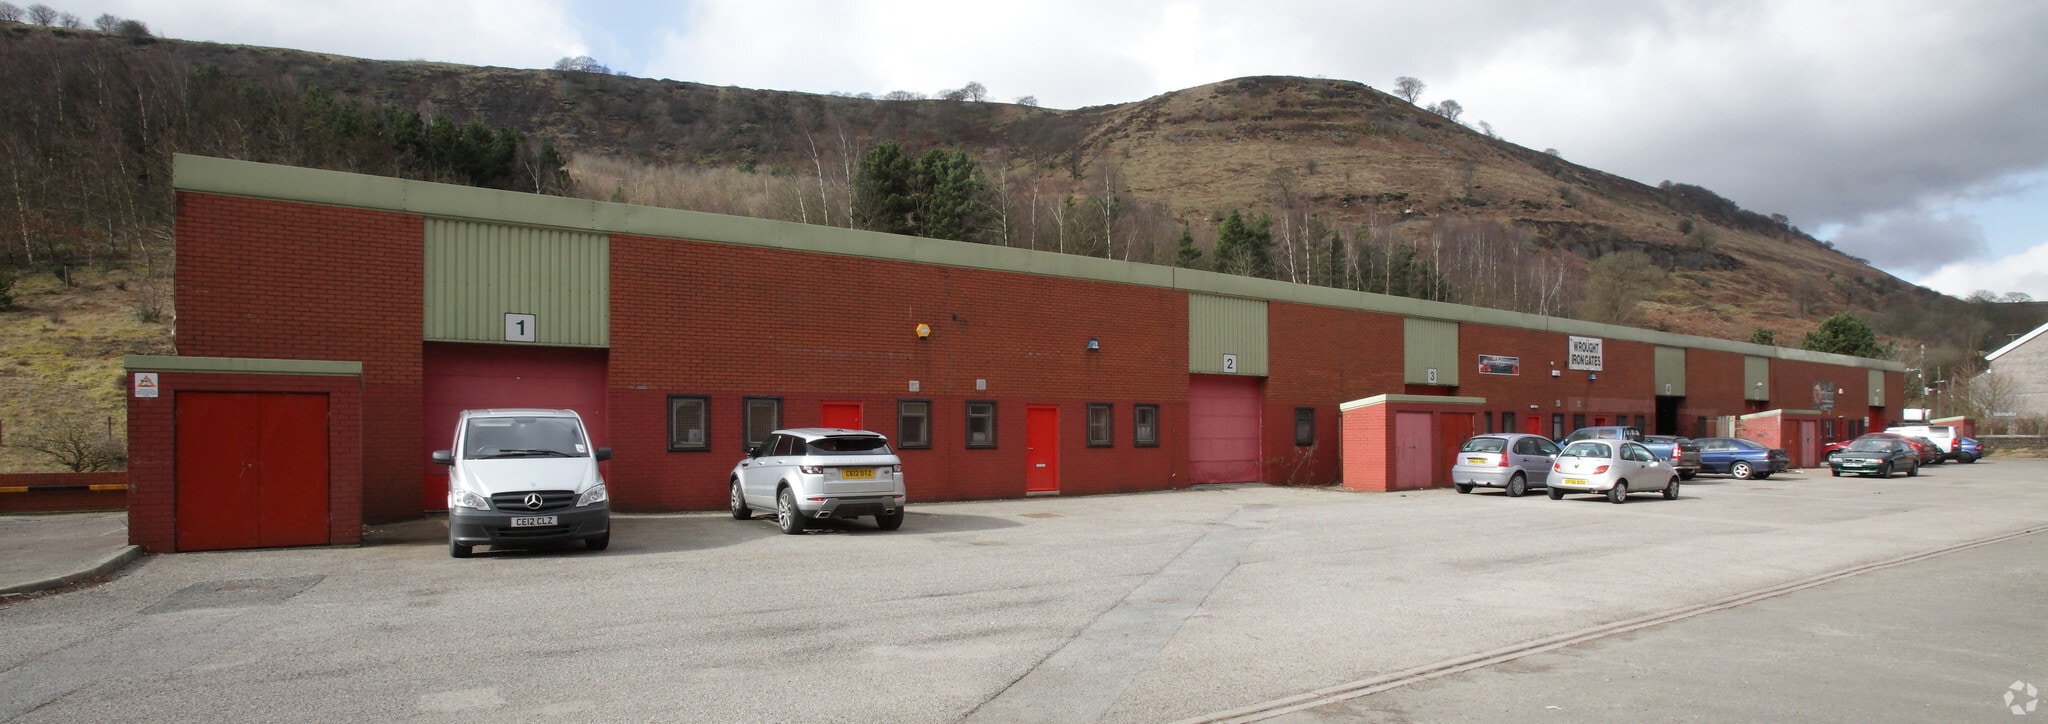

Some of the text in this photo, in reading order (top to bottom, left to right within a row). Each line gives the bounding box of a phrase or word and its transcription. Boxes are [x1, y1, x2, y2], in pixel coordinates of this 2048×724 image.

[515, 319, 525, 336] 1
[1573, 341, 1599, 353] WROUGHT
[1227, 358, 1233, 369] 2
[1572, 353, 1601, 366] IRON GATES
[1429, 371, 1435, 381] 3
[516, 516, 553, 526] CE12 CLZ
